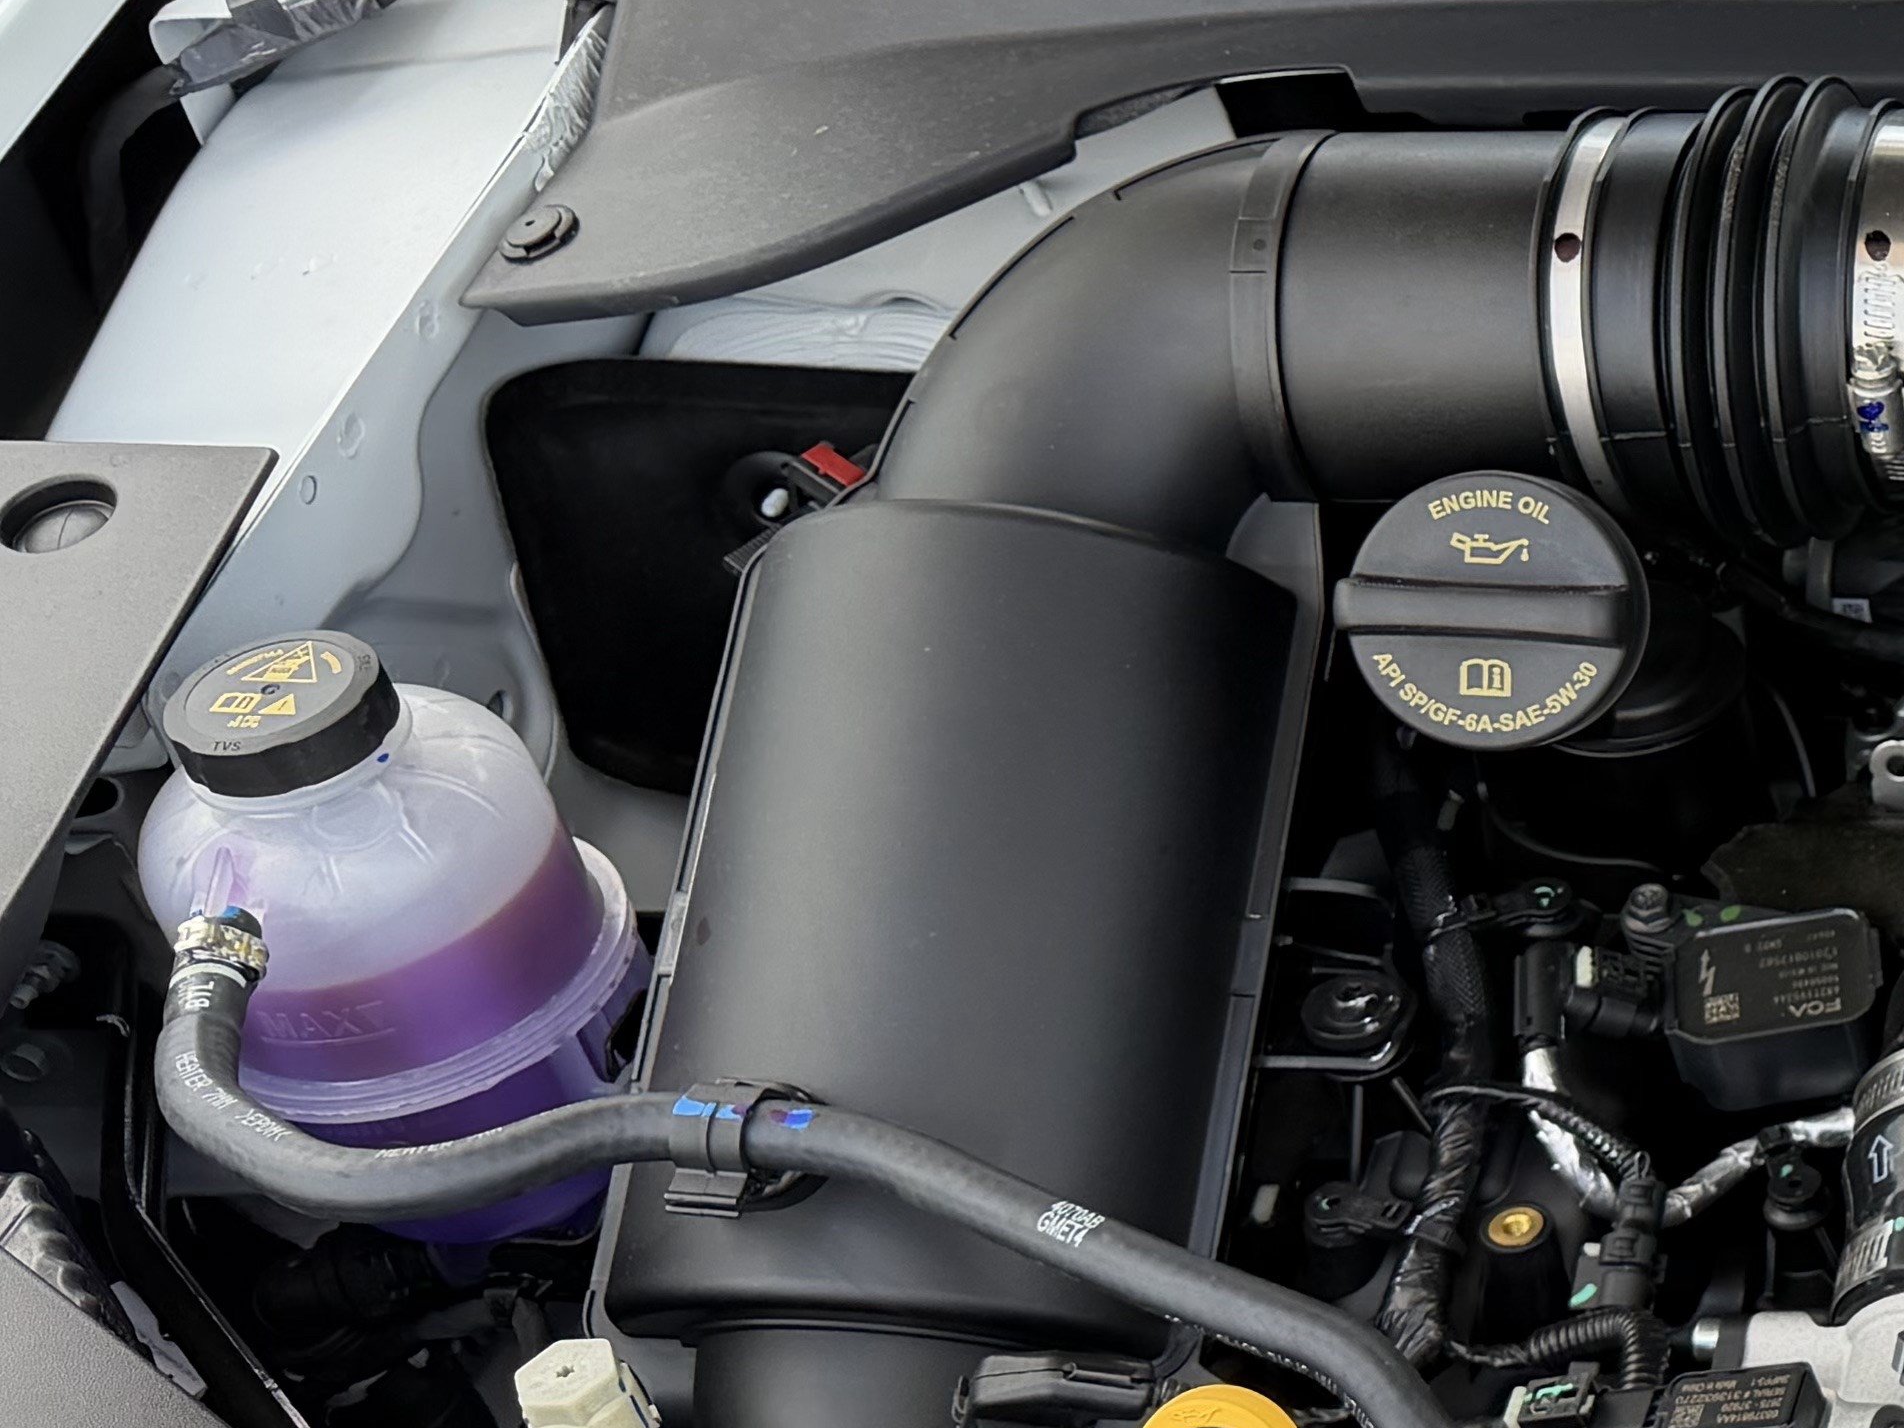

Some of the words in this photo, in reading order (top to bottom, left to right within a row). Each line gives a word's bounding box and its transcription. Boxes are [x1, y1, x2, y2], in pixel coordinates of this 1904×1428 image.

[1428, 490, 1513, 521] ENGINE
[1517, 496, 1552, 525] OIL
[1372, 651, 1407, 693] API
[1399, 661, 1599, 735] SP/GF-6A-SAE-5W-30
[212, 740, 242, 753] TVS
[1789, 998, 1842, 1019] FCA
[176, 1050, 214, 1092] HEATER
